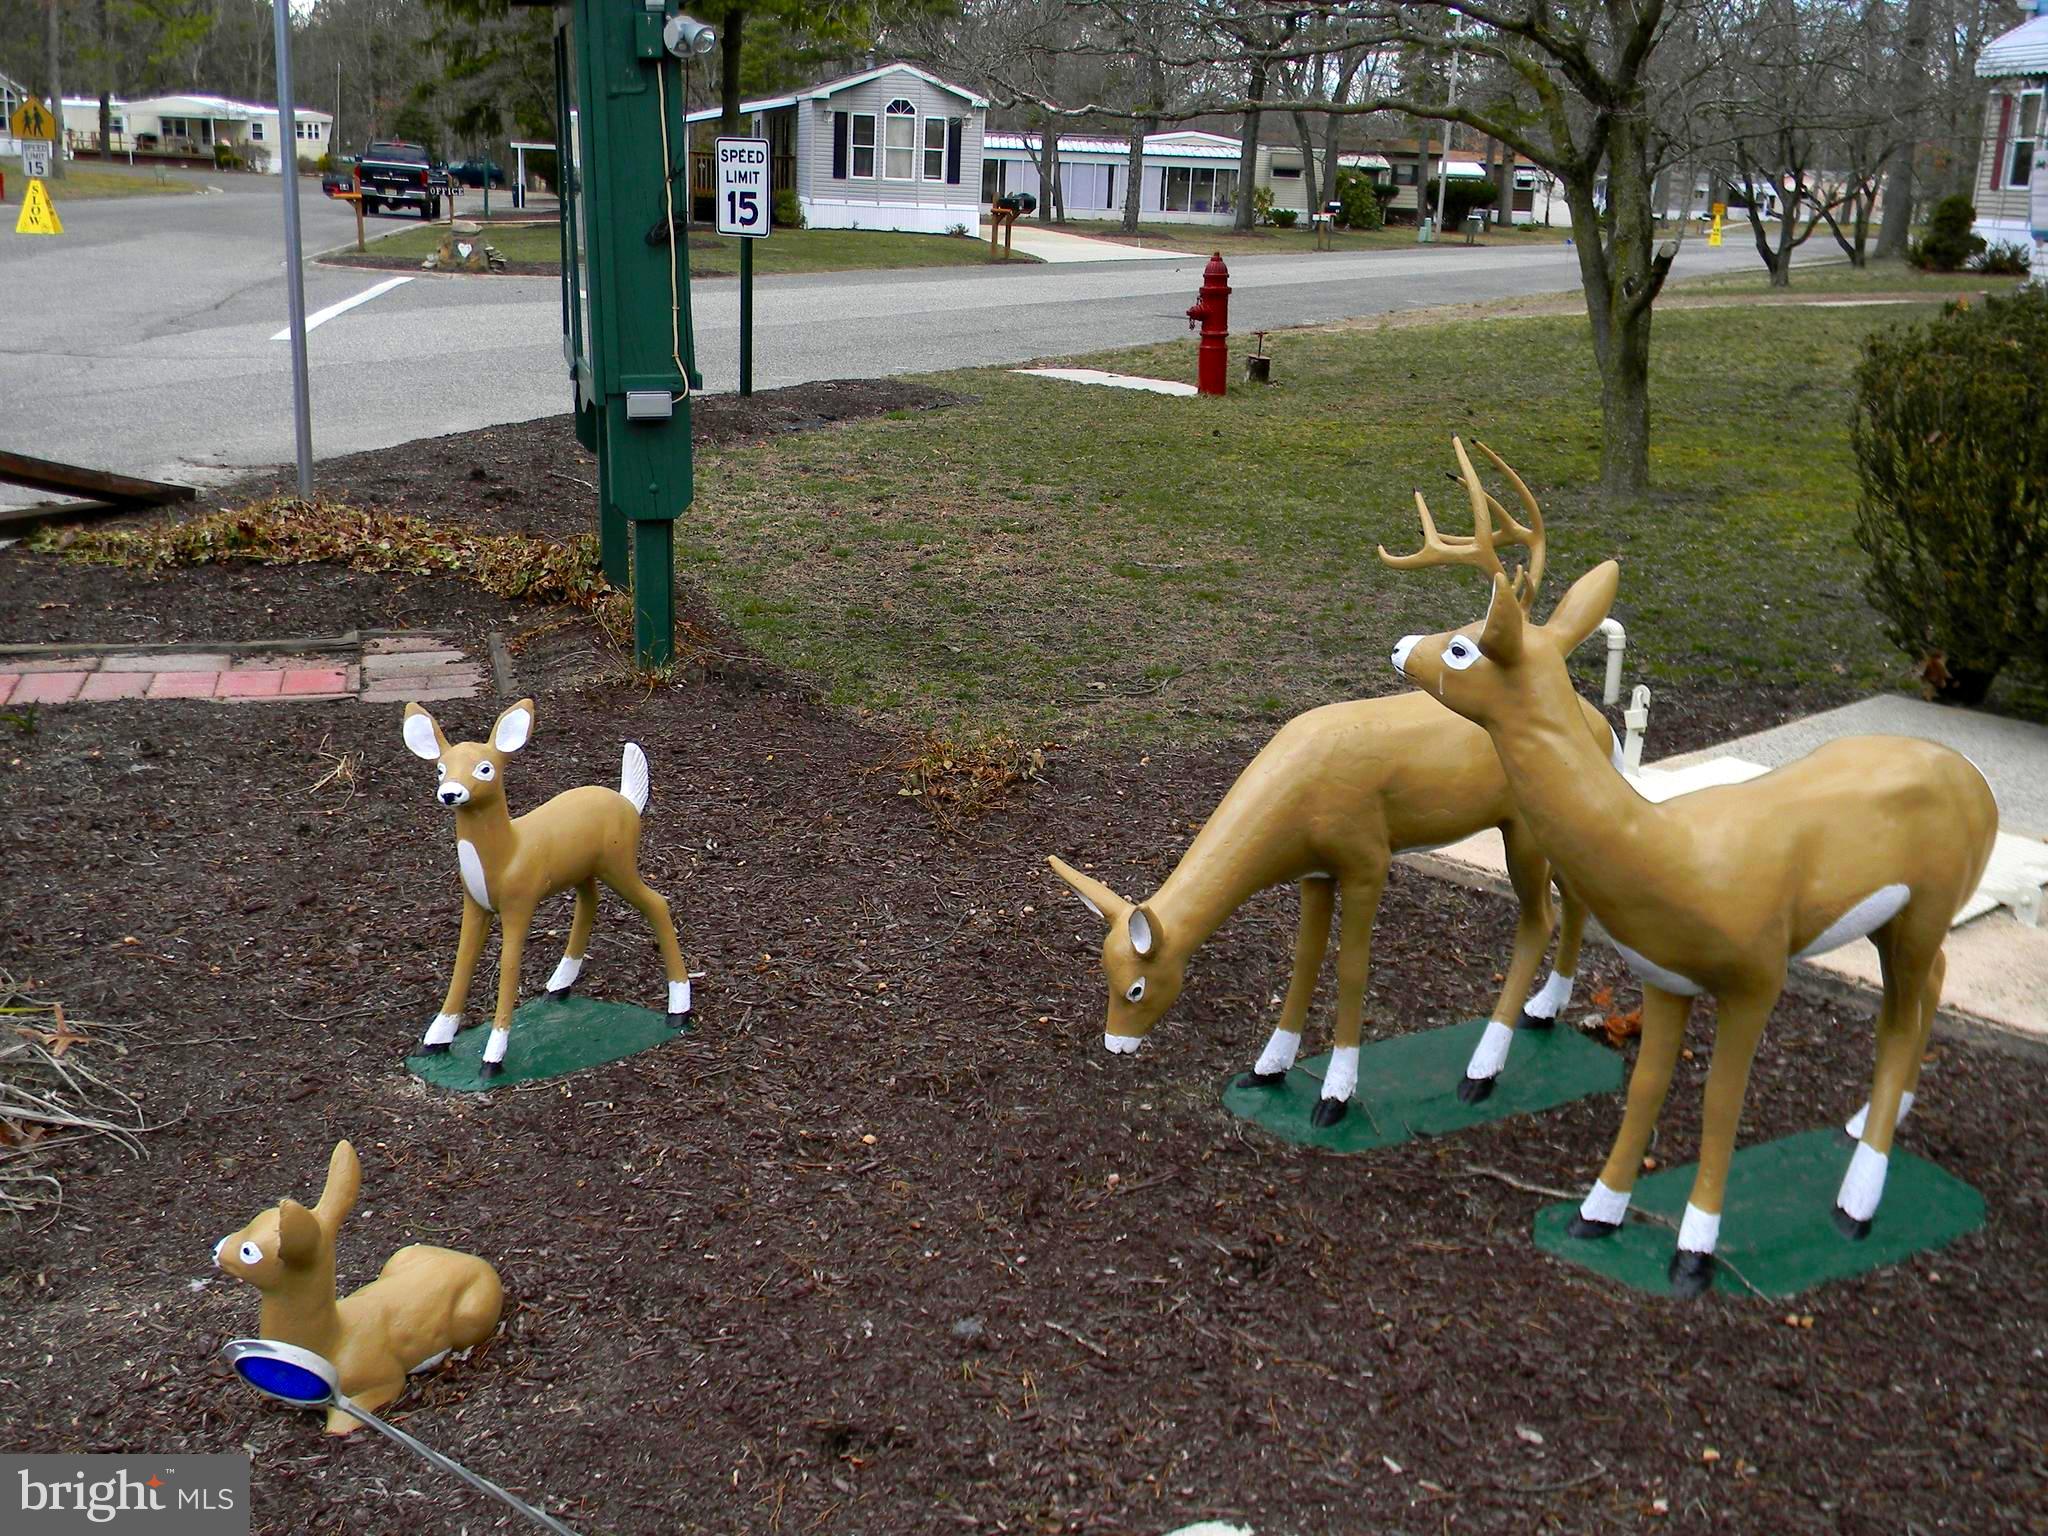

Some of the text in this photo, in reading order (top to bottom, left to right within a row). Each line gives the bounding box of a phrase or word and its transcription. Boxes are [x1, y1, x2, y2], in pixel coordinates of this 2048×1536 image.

[23, 143, 47, 152] SPEED
[26, 152, 45, 160] LIMIT
[720, 148, 765, 164] SPEED
[28, 161, 44, 175] 15
[726, 170, 760, 185] LIMIT
[430, 186, 464, 196] OFFICE
[29, 185, 41, 225] SLOW
[727, 190, 759, 226] 15
